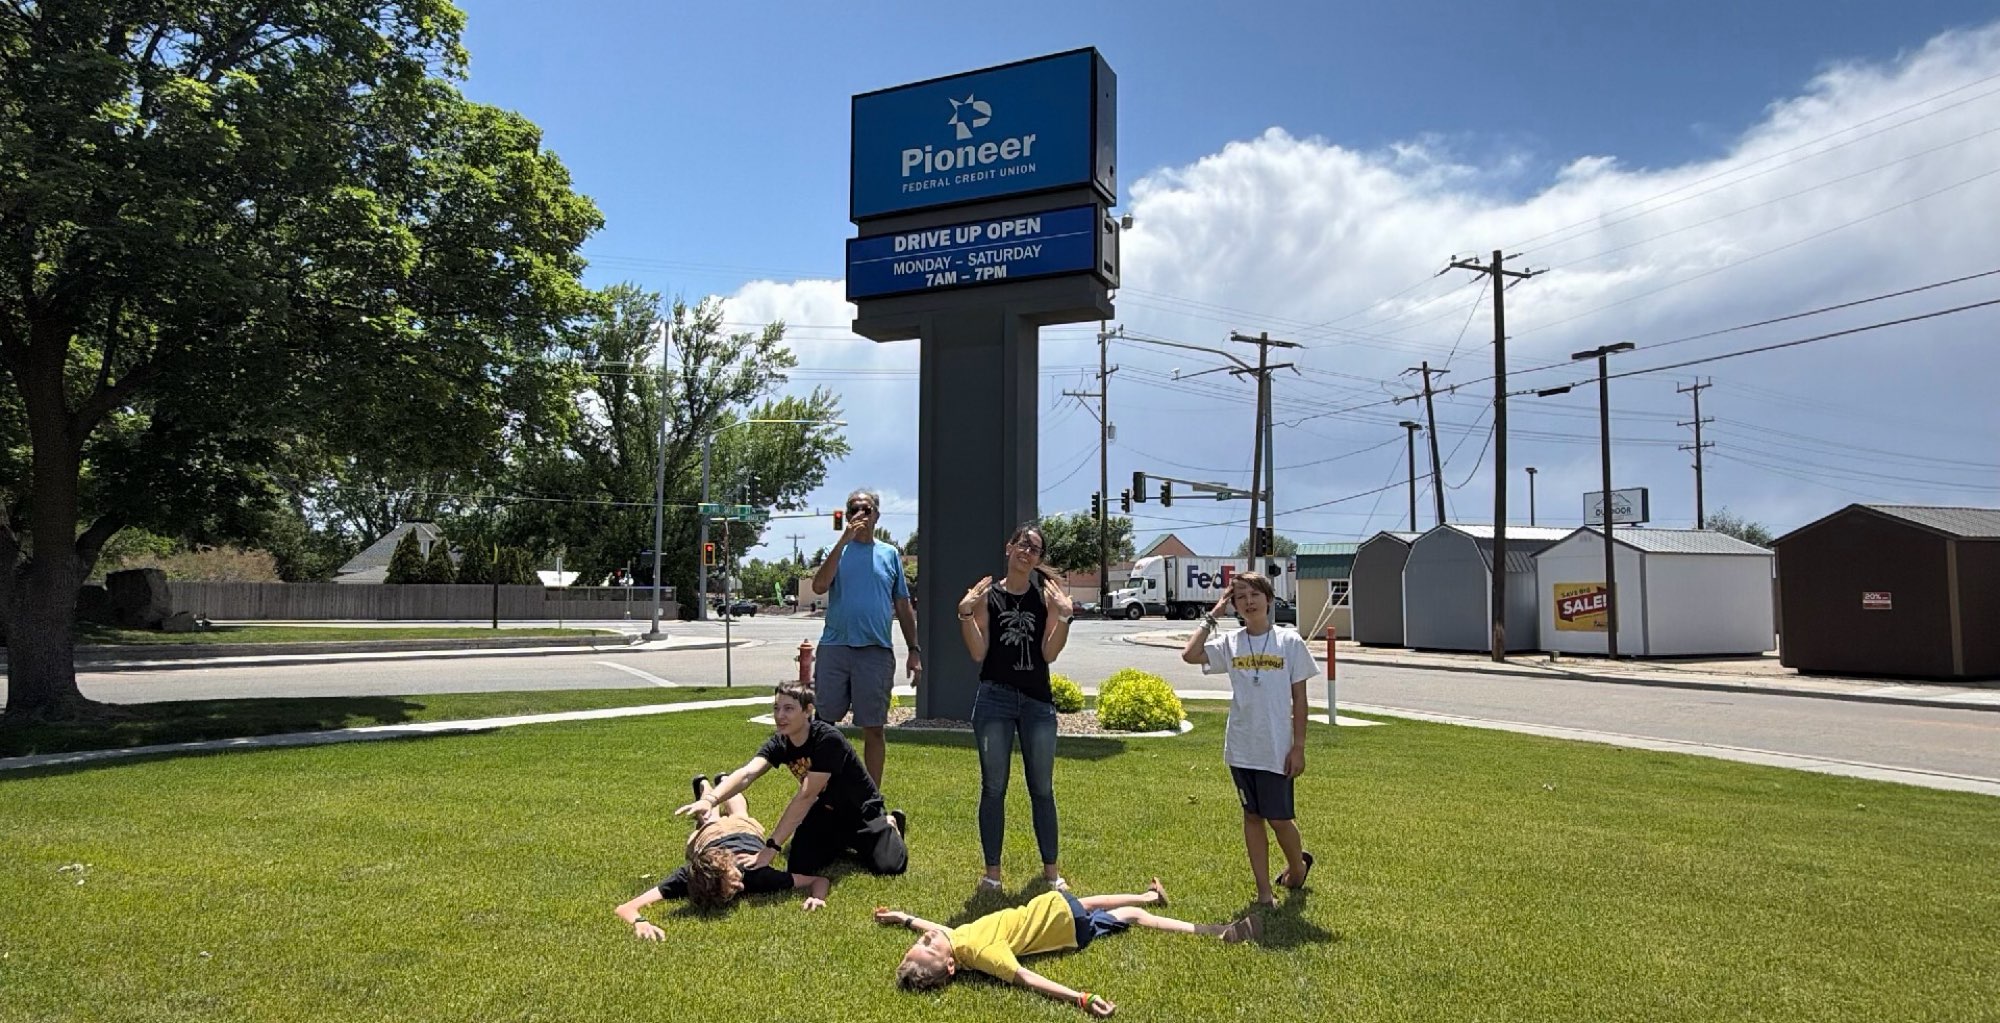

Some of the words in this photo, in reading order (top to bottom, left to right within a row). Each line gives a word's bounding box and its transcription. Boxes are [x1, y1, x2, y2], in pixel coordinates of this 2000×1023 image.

[901, 133, 1036, 177] Pioneer
[902, 177, 951, 193] FEDERAL
[955, 169, 996, 185] CREDIT
[1000, 163, 1036, 177] UNION
[894, 229, 951, 252] DRIVE
[955, 225, 982, 243] UP
[986, 217, 1041, 239] OPEN
[893, 256, 952, 275] MONDAY
[968, 244, 1042, 266] SATURDAY
[925, 272, 957, 287] 7AM
[974, 264, 1007, 281] 7PM
[1187, 565, 1236, 588] FedE
[1560, 589, 1578, 597] SAVE
[1562, 594, 1607, 615] SALE!
